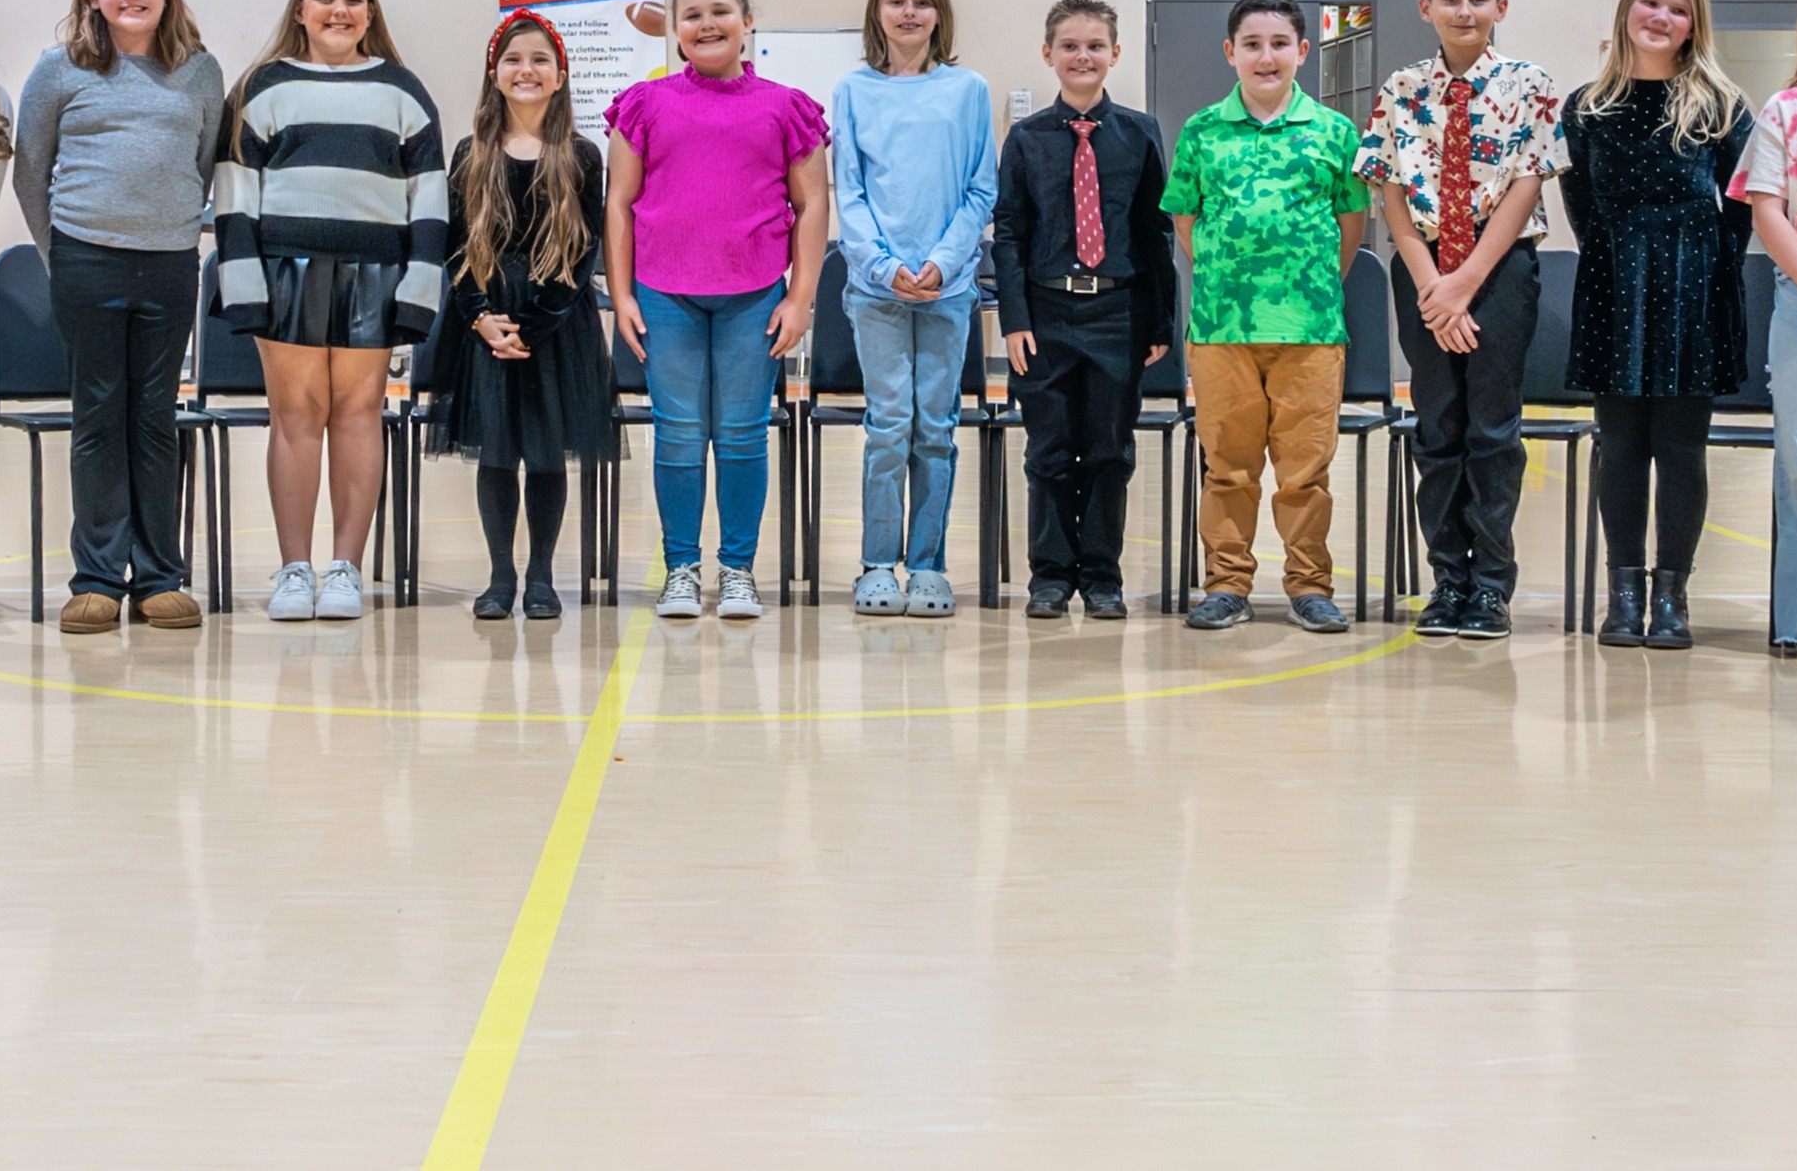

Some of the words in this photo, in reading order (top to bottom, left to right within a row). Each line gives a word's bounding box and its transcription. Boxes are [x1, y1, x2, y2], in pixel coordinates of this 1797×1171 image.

[558, 20, 566, 28] in
[568, 20, 582, 28] and
[584, 20, 609, 28] follow
[579, 29, 612, 37] routine.
[609, 45, 634, 53] tennis
[572, 71, 581, 79] all
[582, 71, 592, 79] of
[593, 71, 606, 79] the
[608, 70, 630, 78] rules.
[596, 87, 609, 95] the
[573, 113, 603, 121] ourself,
